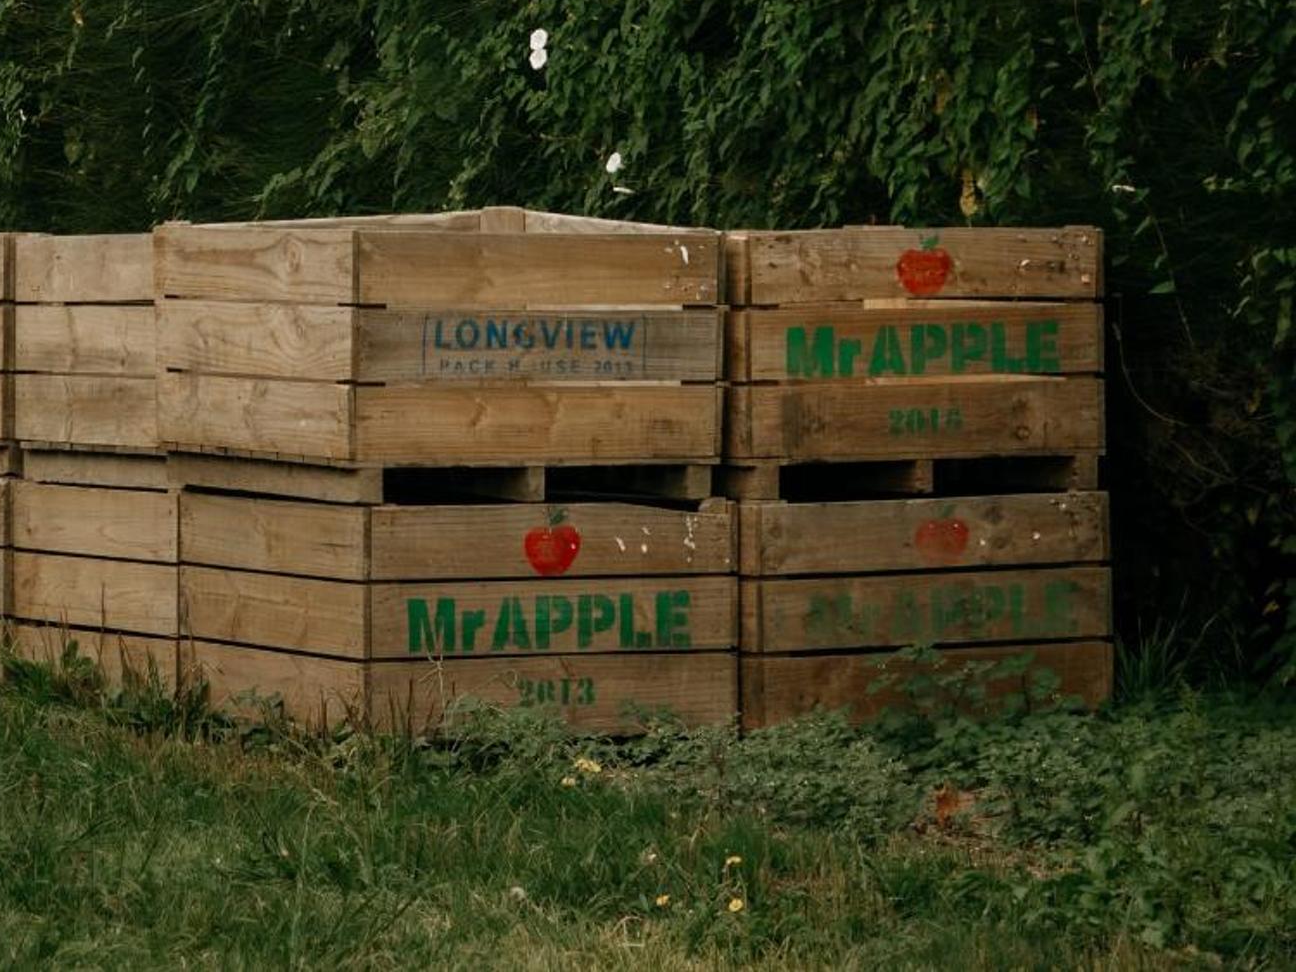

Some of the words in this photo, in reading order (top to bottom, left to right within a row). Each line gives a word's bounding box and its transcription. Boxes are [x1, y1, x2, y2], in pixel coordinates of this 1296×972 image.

[434, 318, 637, 350] LONGVIEW
[439, 359, 497, 374] PACK
[508, 359, 580, 374] HUSE
